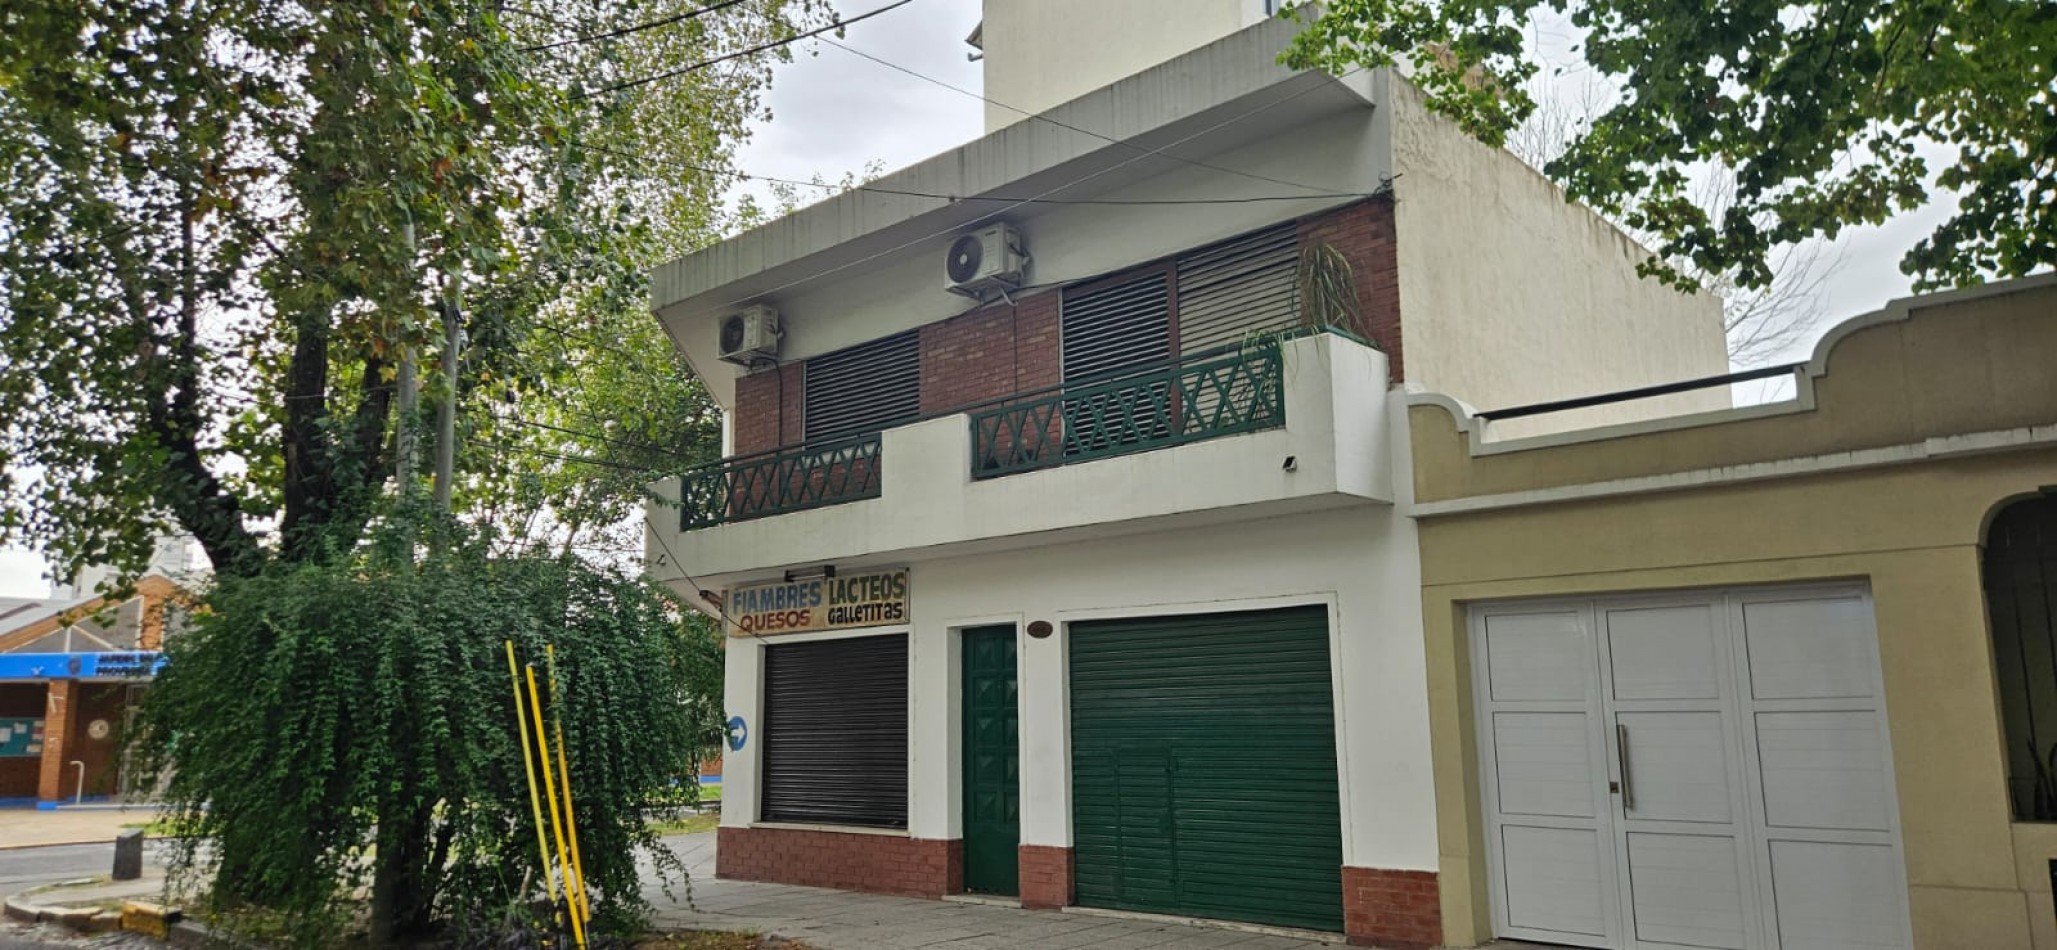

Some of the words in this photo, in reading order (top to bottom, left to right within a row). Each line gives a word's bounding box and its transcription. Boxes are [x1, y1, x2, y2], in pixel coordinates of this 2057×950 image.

[733, 581, 821, 613] FIAMBRES
[829, 572, 904, 604] LACTEOS
[741, 609, 811, 632] QUESOS
